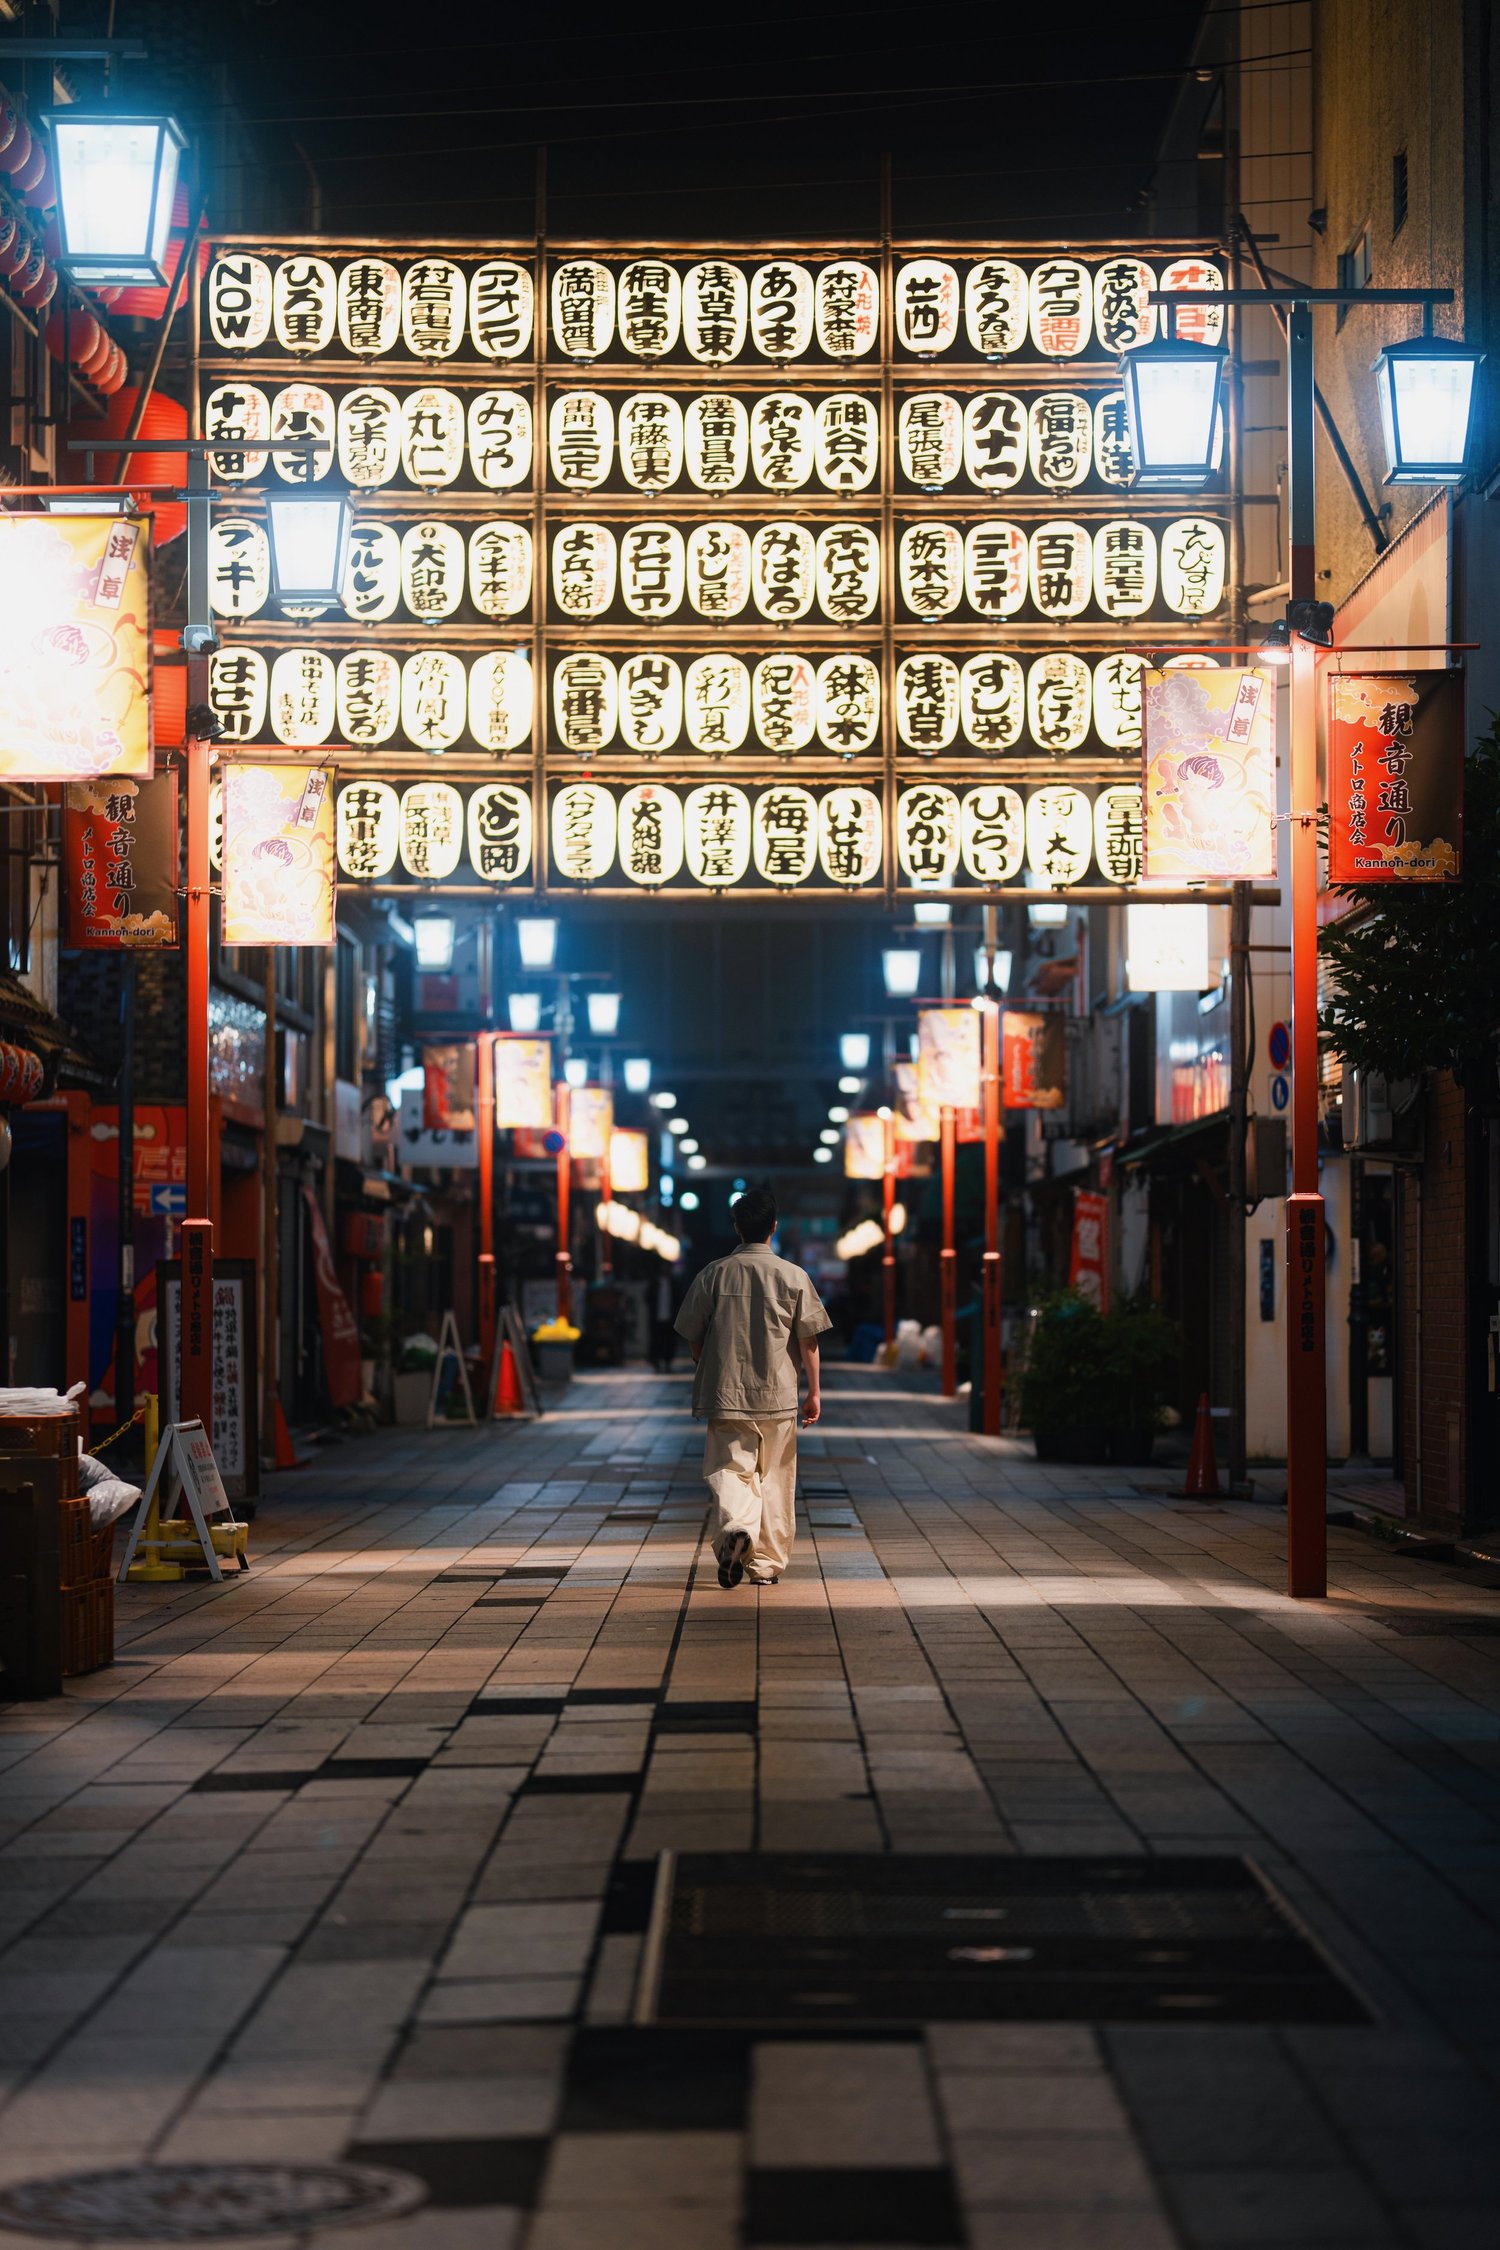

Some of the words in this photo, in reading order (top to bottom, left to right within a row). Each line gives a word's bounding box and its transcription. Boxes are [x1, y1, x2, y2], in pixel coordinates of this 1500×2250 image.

[216, 262, 251, 339] NOW
[282, 264, 325, 344] ひろ里
[346, 265, 384, 347] 東南屋
[559, 266, 597, 351] 満留賀
[623, 265, 671, 350] 桐生堂
[757, 266, 797, 352] あつま
[855, 270, 872, 335] 人形焼
[1101, 264, 1139, 350] 志ぬや
[211, 392, 246, 474] 十和田
[343, 394, 391, 481] 今半別館
[408, 410, 447, 478] 丸仁
[477, 396, 514, 480] みつや
[558, 398, 602, 481] 雷門三定
[758, 399, 802, 482] 和泉屋
[905, 400, 944, 480] 尾張屋
[99, 533, 135, 600] 浅草
[216, 523, 256, 608] ラッキー
[411, 543, 448, 611] 犬印鞄
[629, 530, 672, 611] アゼリア
[697, 530, 731, 610] ふじ屋
[760, 529, 800, 614] みはる
[907, 530, 949, 611] 栃木家
[973, 533, 1010, 610] テラオ
[1037, 534, 1075, 609] 百助
[1172, 524, 1216, 610] えびす屋
[345, 658, 378, 738] まさる
[761, 664, 796, 747] 紀文堂
[823, 663, 870, 746] 鉢の木
[1231, 685, 1259, 738] 浅草
[301, 778, 325, 823] 浅草
[1349, 741, 1367, 846] メトロ商店会
[1377, 701, 1414, 849] 観音通り
[81, 826, 97, 918] メトロ商店会
[105, 793, 136, 920] 観音通り
[906, 792, 946, 874] なか山
[968, 795, 1011, 875] ひらい
[1355, 856, 1435, 869] Kannon-dori
[86, 926, 155, 938] Kannon-dori
